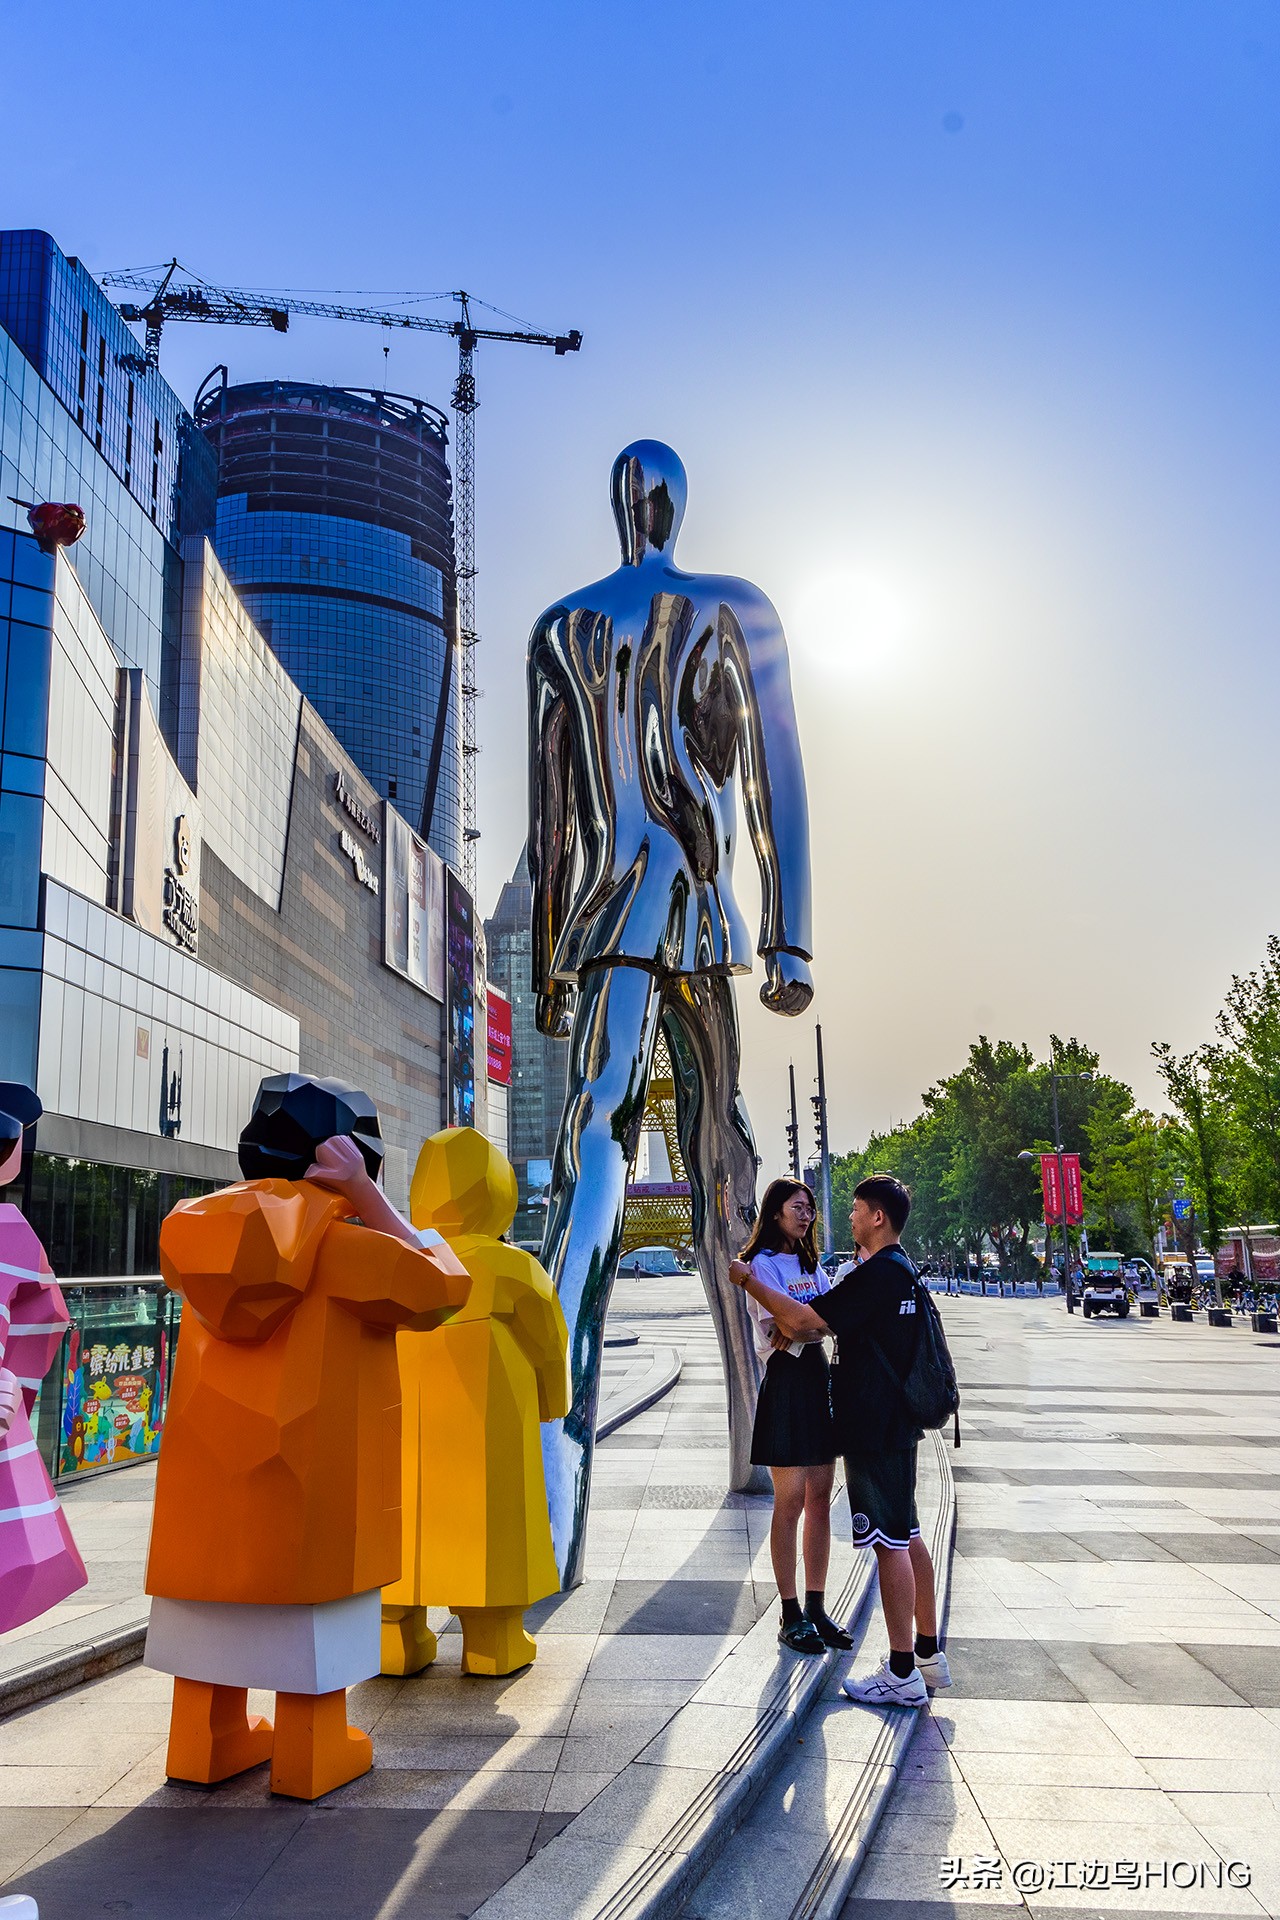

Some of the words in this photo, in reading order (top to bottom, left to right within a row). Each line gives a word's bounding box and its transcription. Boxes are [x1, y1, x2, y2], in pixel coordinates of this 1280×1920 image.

[90, 1349, 155, 1376] 缤纷儿童季
